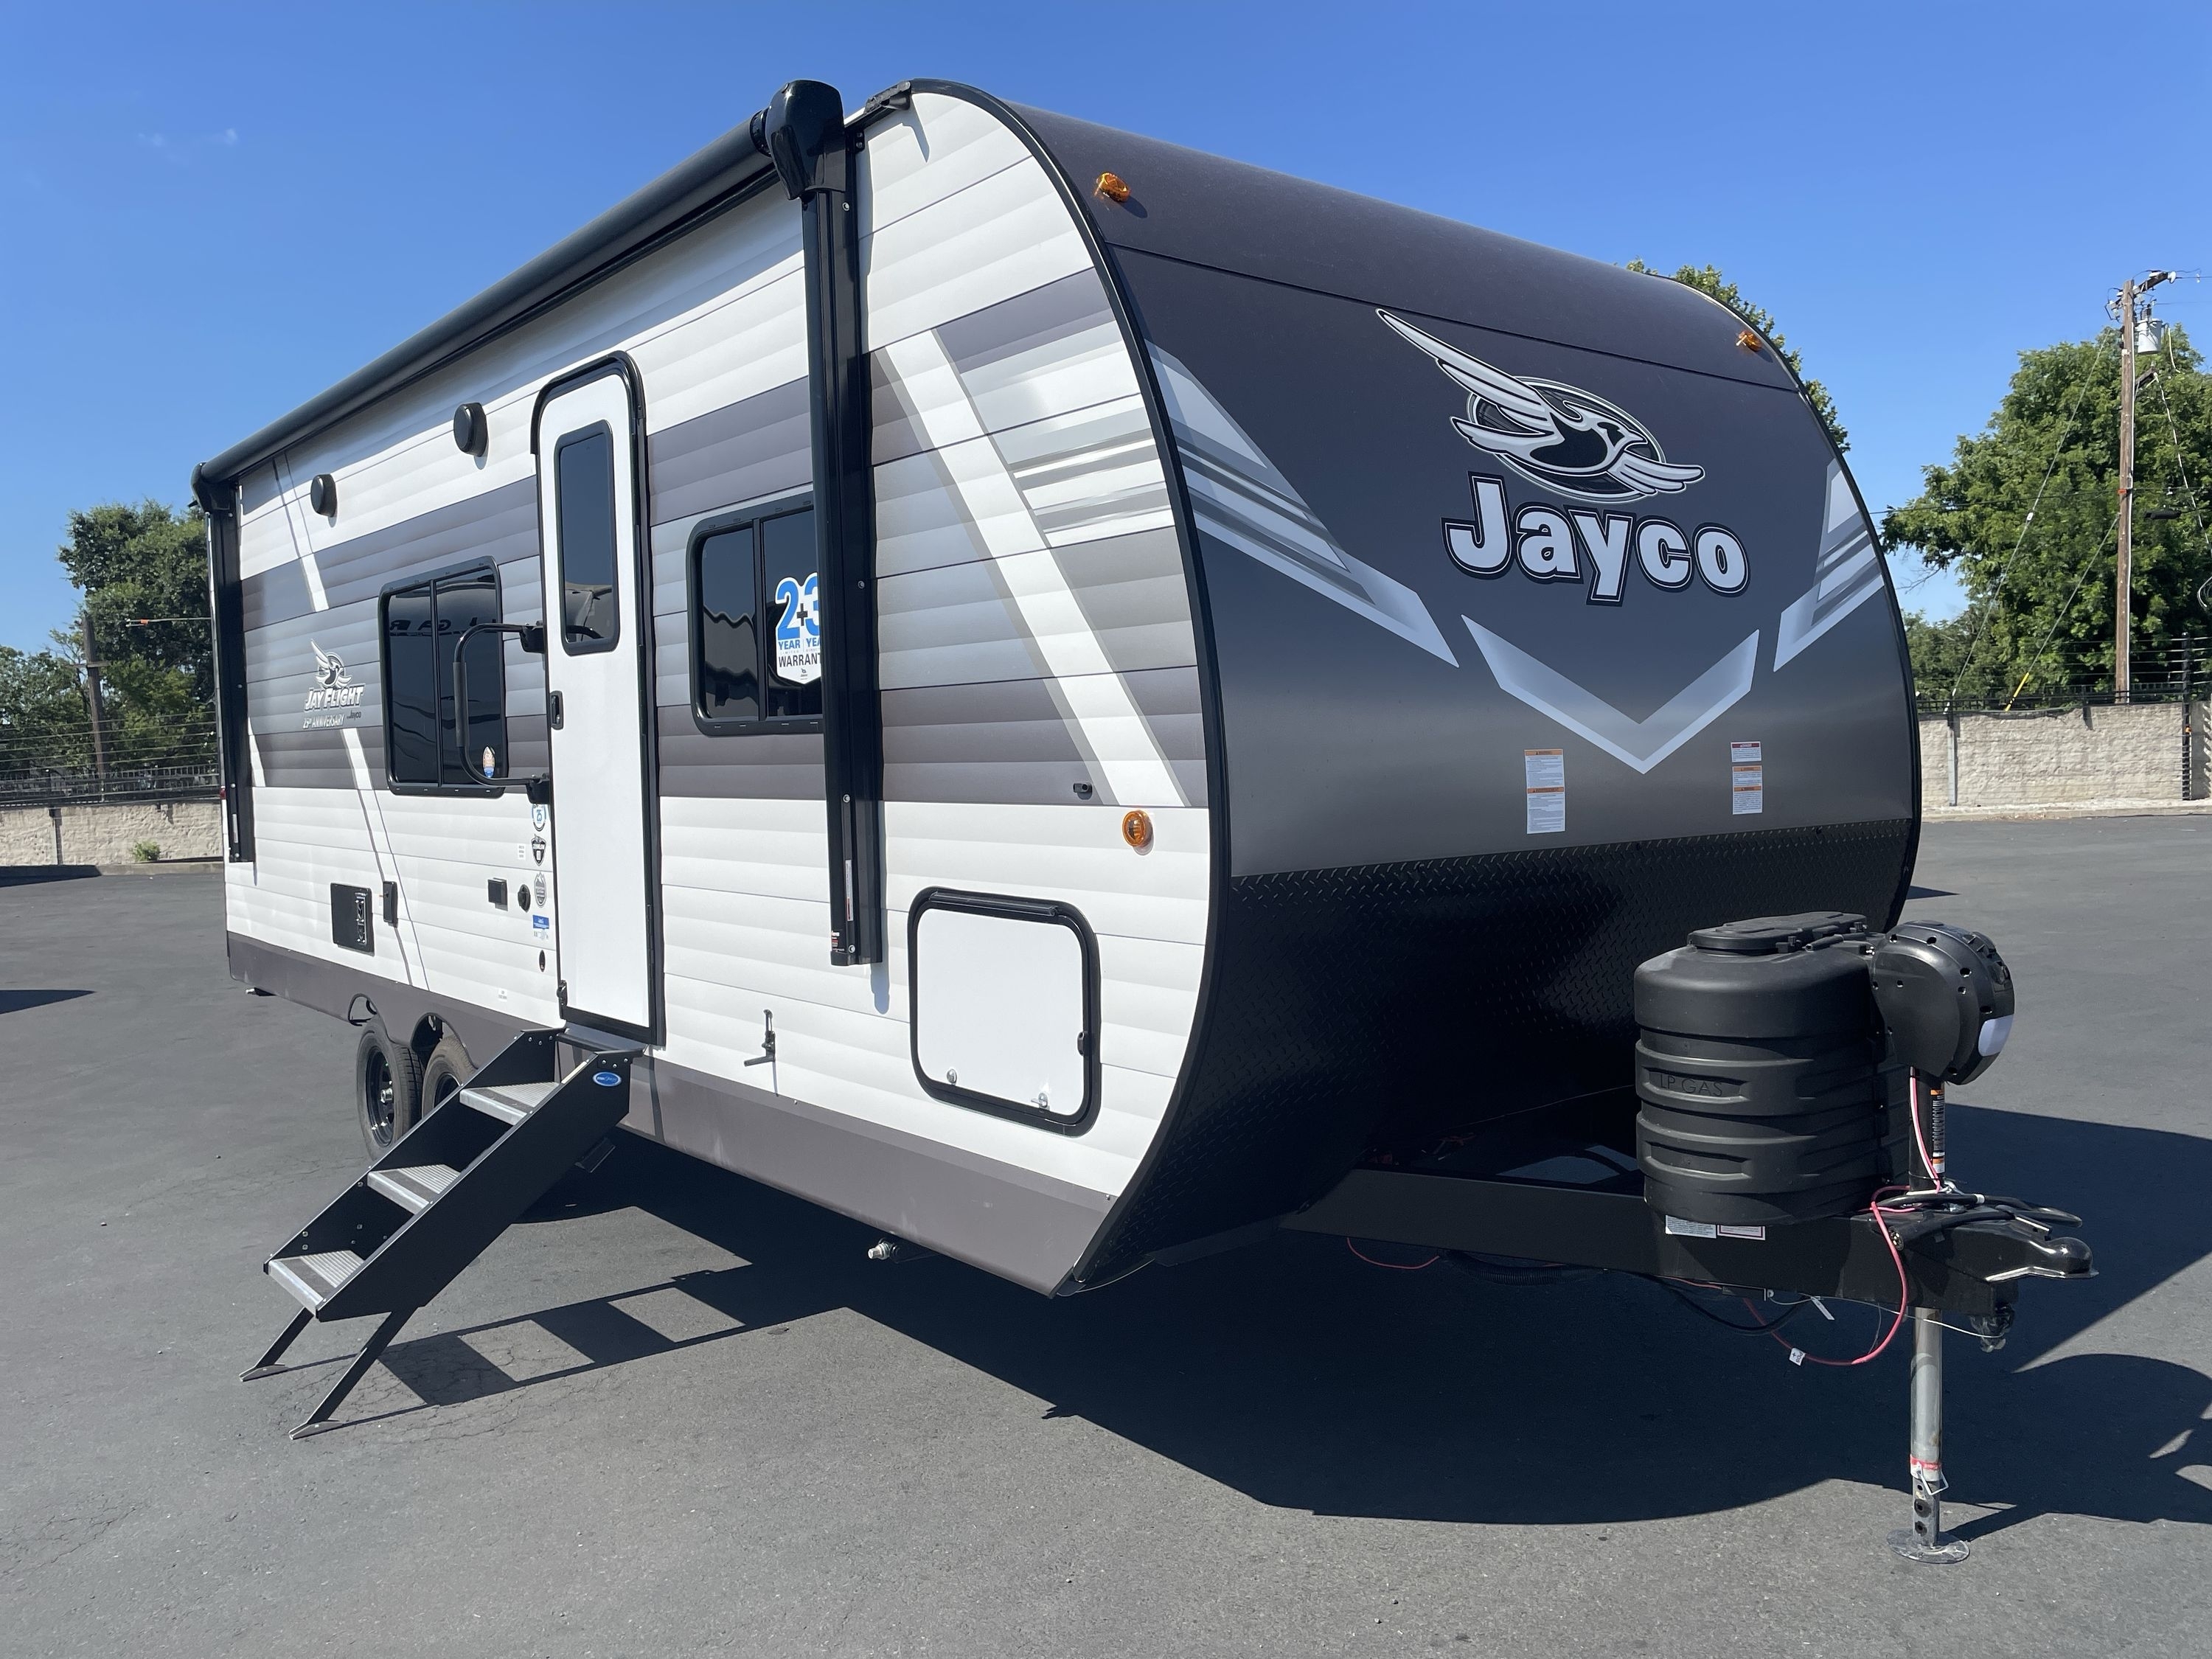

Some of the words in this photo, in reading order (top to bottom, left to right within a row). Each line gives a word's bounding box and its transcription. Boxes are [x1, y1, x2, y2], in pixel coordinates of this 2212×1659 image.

[1441, 471, 1750, 606] Jayco
[778, 639, 801, 650] YEAR
[806, 637, 820, 647] YE
[779, 653, 820, 667] WARRAN
[305, 689, 324, 710] JAY
[324, 686, 364, 709] FLIGHT
[312, 713, 345, 728] ANNIVERSARY
[1660, 1074, 1676, 1089] LP
[1681, 1077, 1723, 1097] GAS
